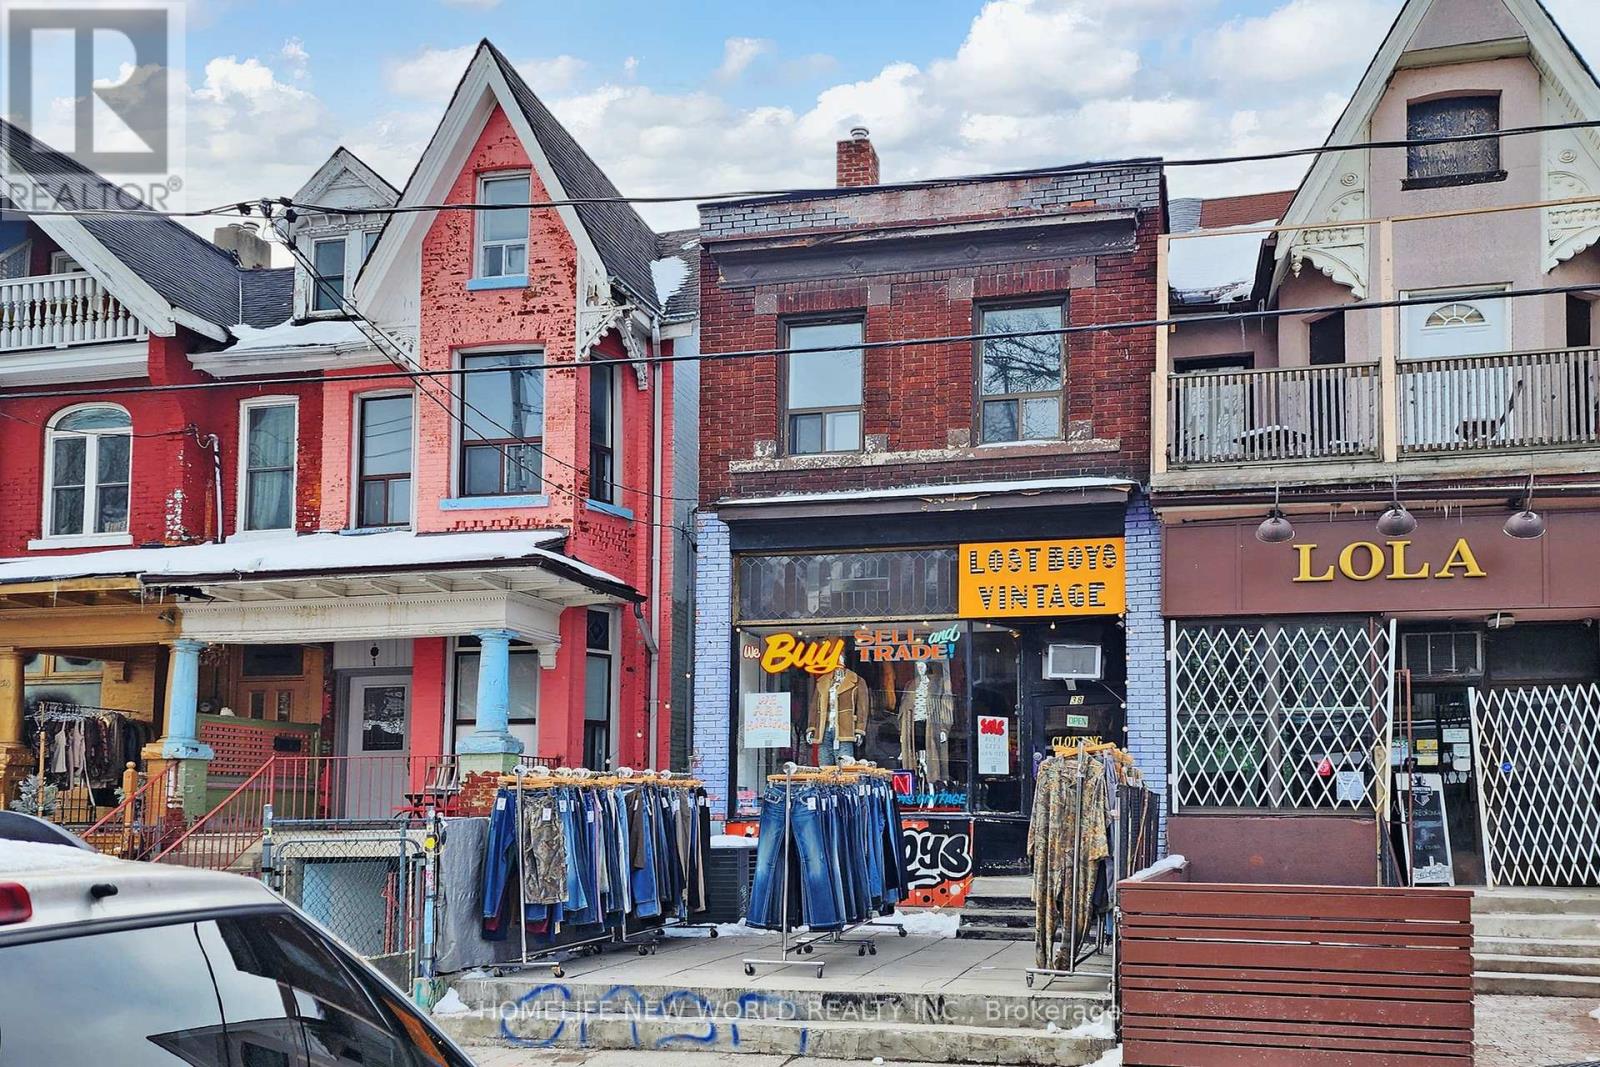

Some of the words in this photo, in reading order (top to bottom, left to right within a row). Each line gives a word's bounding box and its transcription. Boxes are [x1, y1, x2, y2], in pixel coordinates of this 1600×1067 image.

[969, 547, 1041, 575] LOST
[1048, 543, 1117, 573] BOYS
[1292, 537, 1488, 582] LOLA
[978, 581, 1106, 611] VINTAGE
[854, 628, 923, 646] SELL
[928, 624, 961, 643] and
[743, 643, 761, 659] We
[760, 632, 845, 675] Buy
